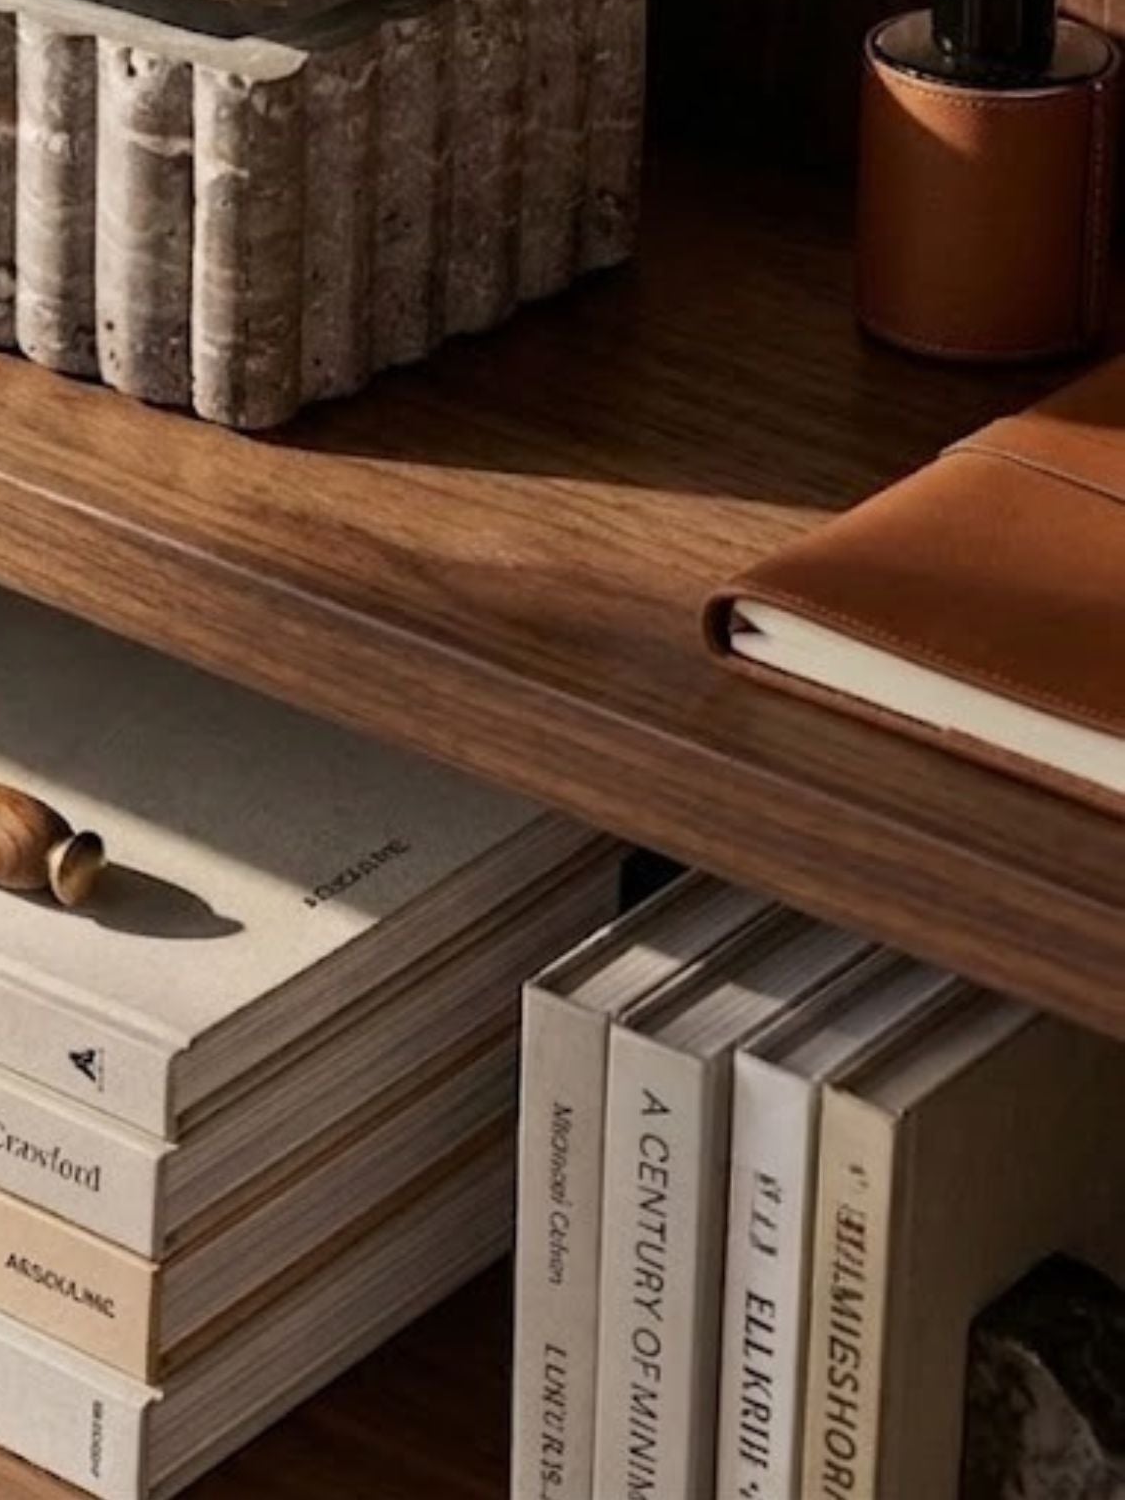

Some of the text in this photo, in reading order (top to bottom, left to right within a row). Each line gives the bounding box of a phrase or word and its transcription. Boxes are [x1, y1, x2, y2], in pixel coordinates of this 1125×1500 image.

[641, 1088, 671, 1116] A
[633, 1132, 670, 1322] CENTURY
[632, 1327, 662, 1382] OF
